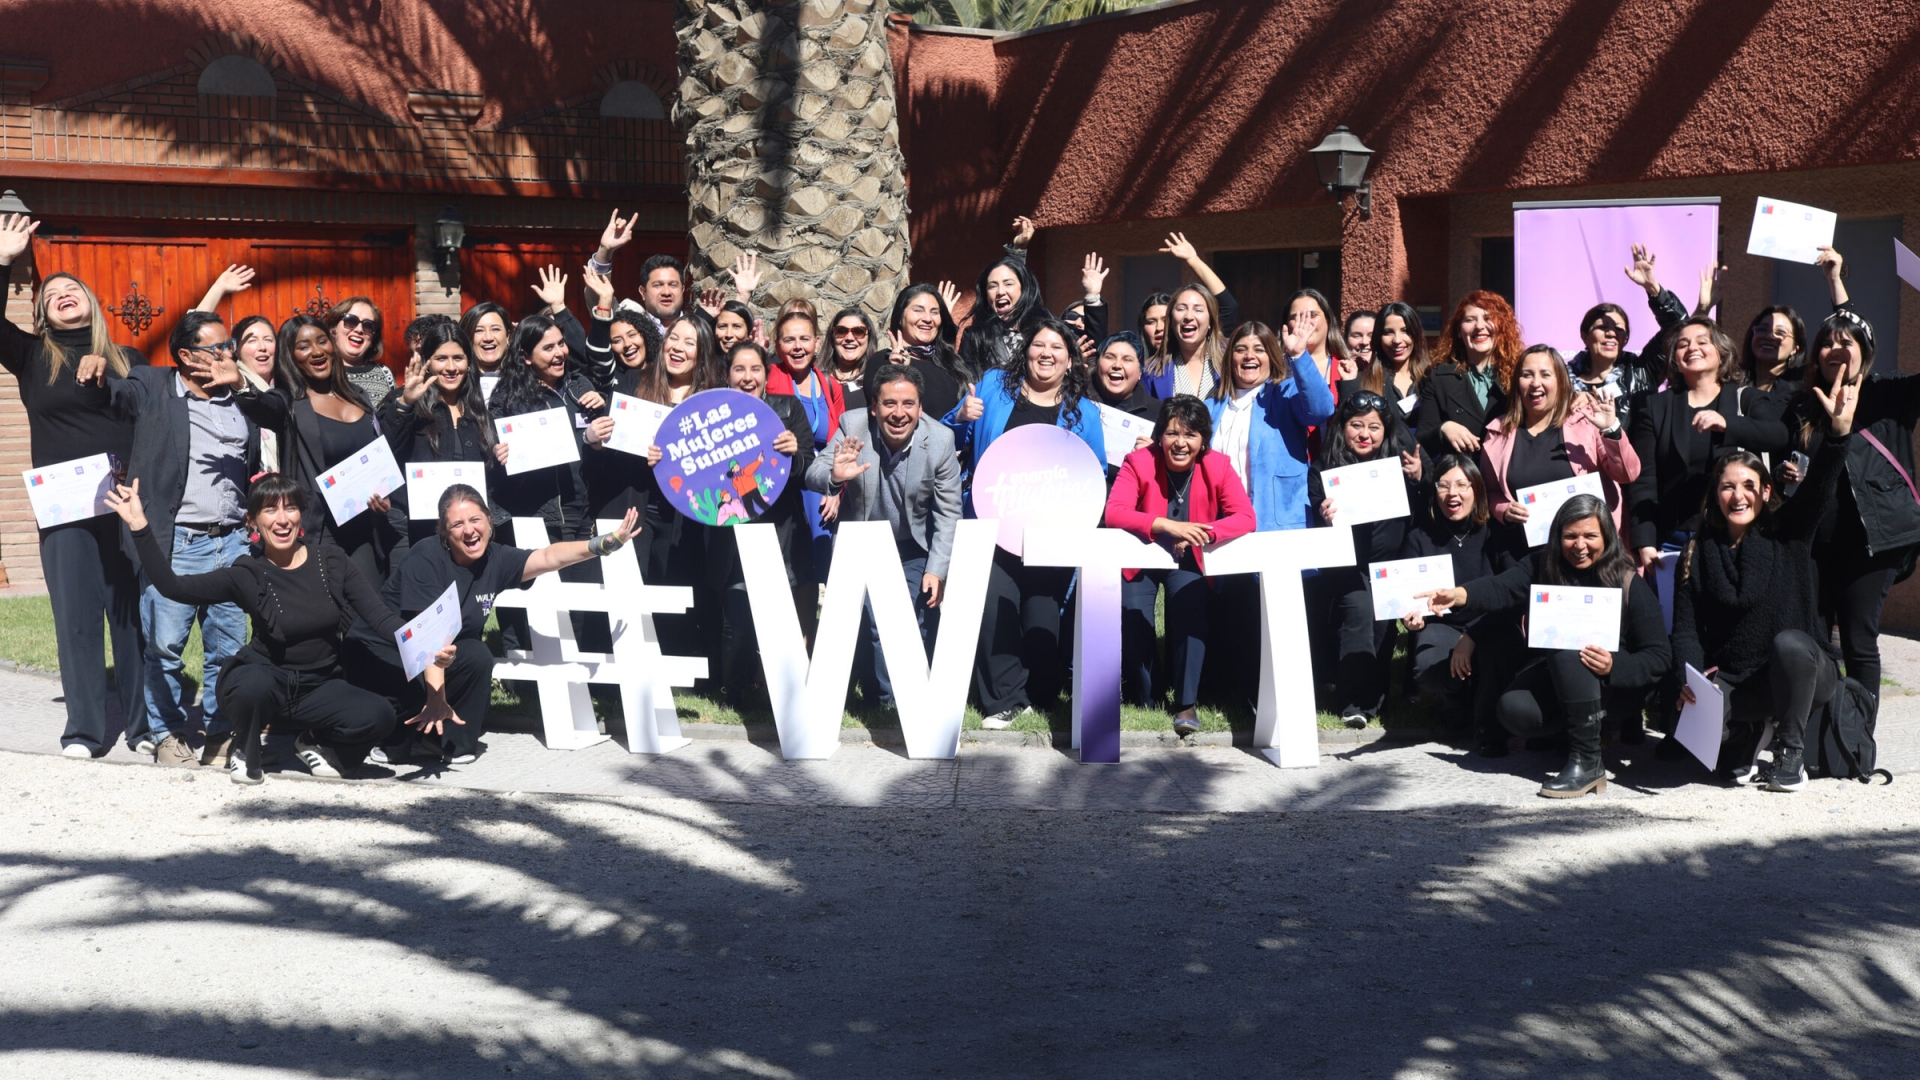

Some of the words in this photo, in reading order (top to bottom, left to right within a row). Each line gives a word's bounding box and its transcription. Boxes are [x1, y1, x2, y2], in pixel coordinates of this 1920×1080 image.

[666, 412, 758, 461] Mujeres
[679, 403, 732, 436] #Las
[680, 432, 760, 476] Suman
[1010, 464, 1069, 484] energía
